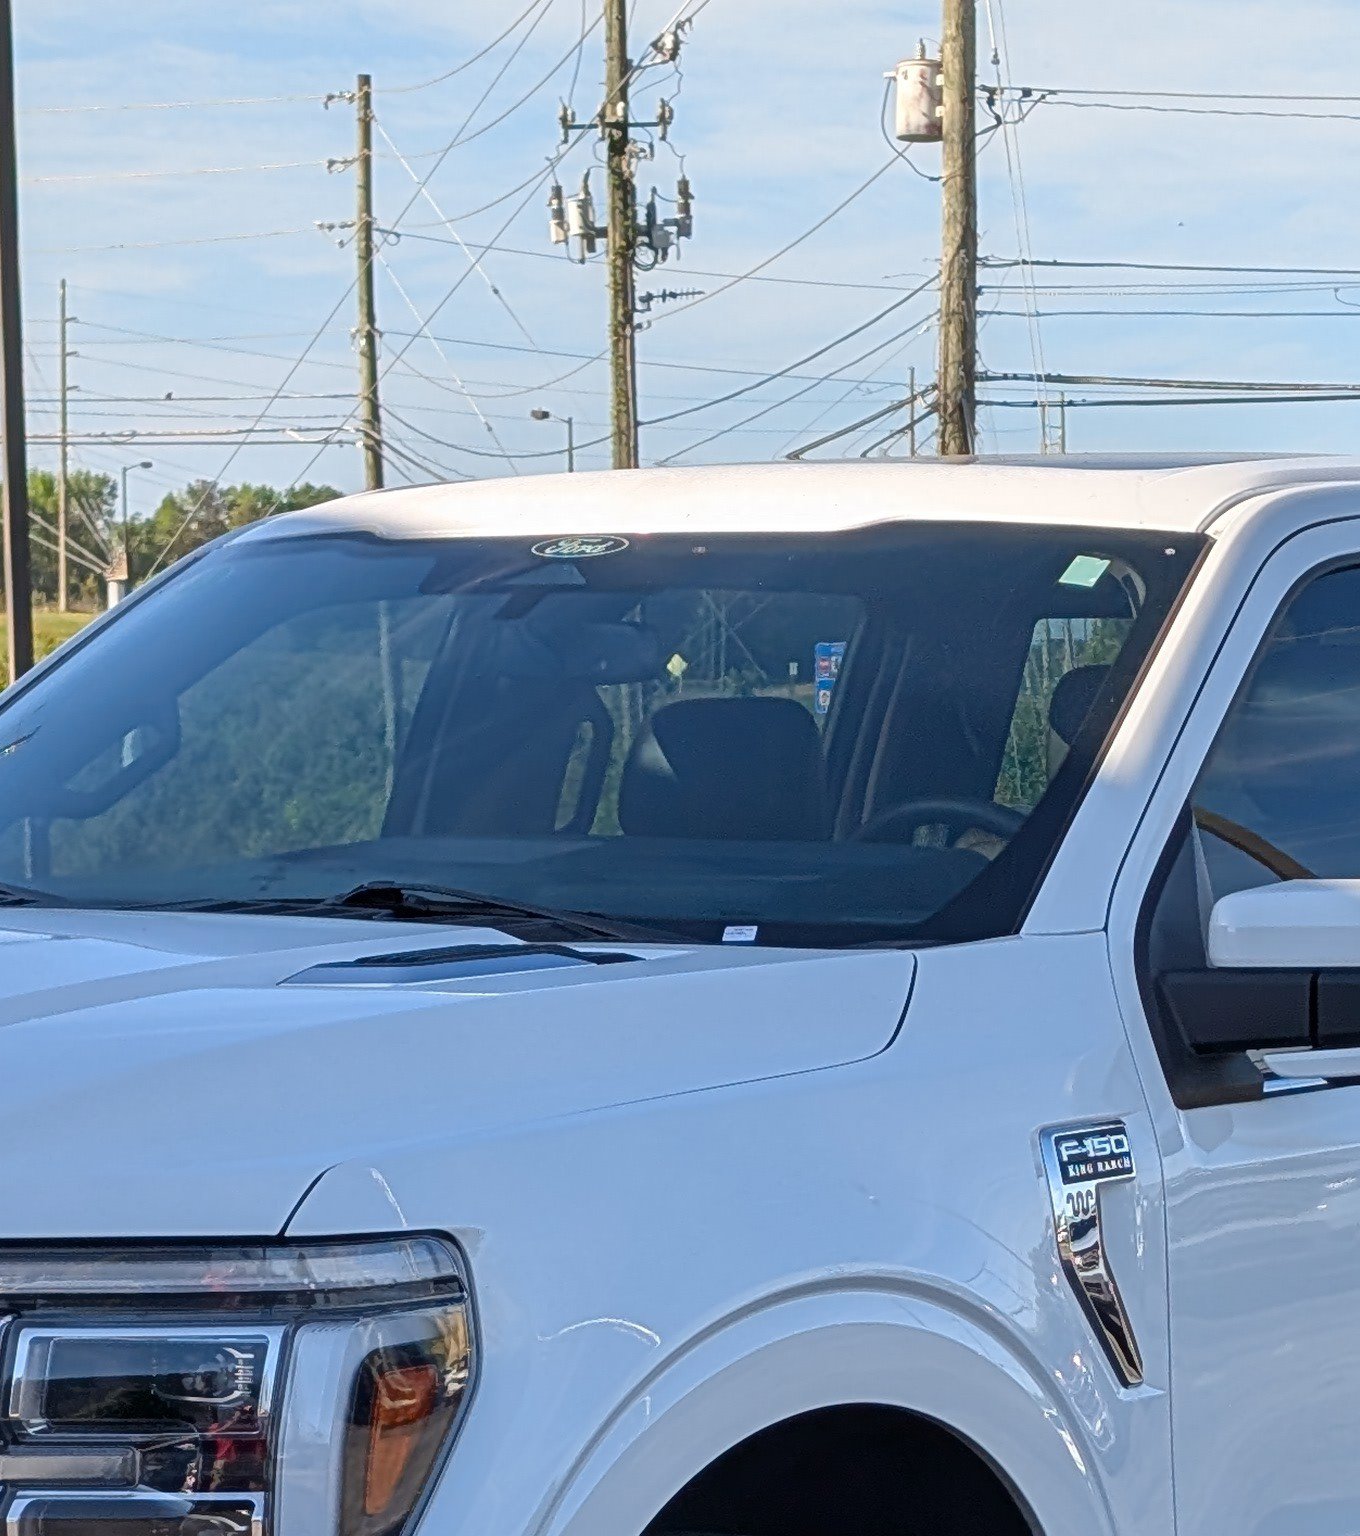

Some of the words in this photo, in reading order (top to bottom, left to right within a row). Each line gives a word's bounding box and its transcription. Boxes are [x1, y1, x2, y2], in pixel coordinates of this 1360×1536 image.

[544, 538, 614, 554] Ford
[1059, 1134, 1129, 1162] F-150
[1068, 1162, 1093, 1178] KING
[1096, 1155, 1131, 1173] RANCH
